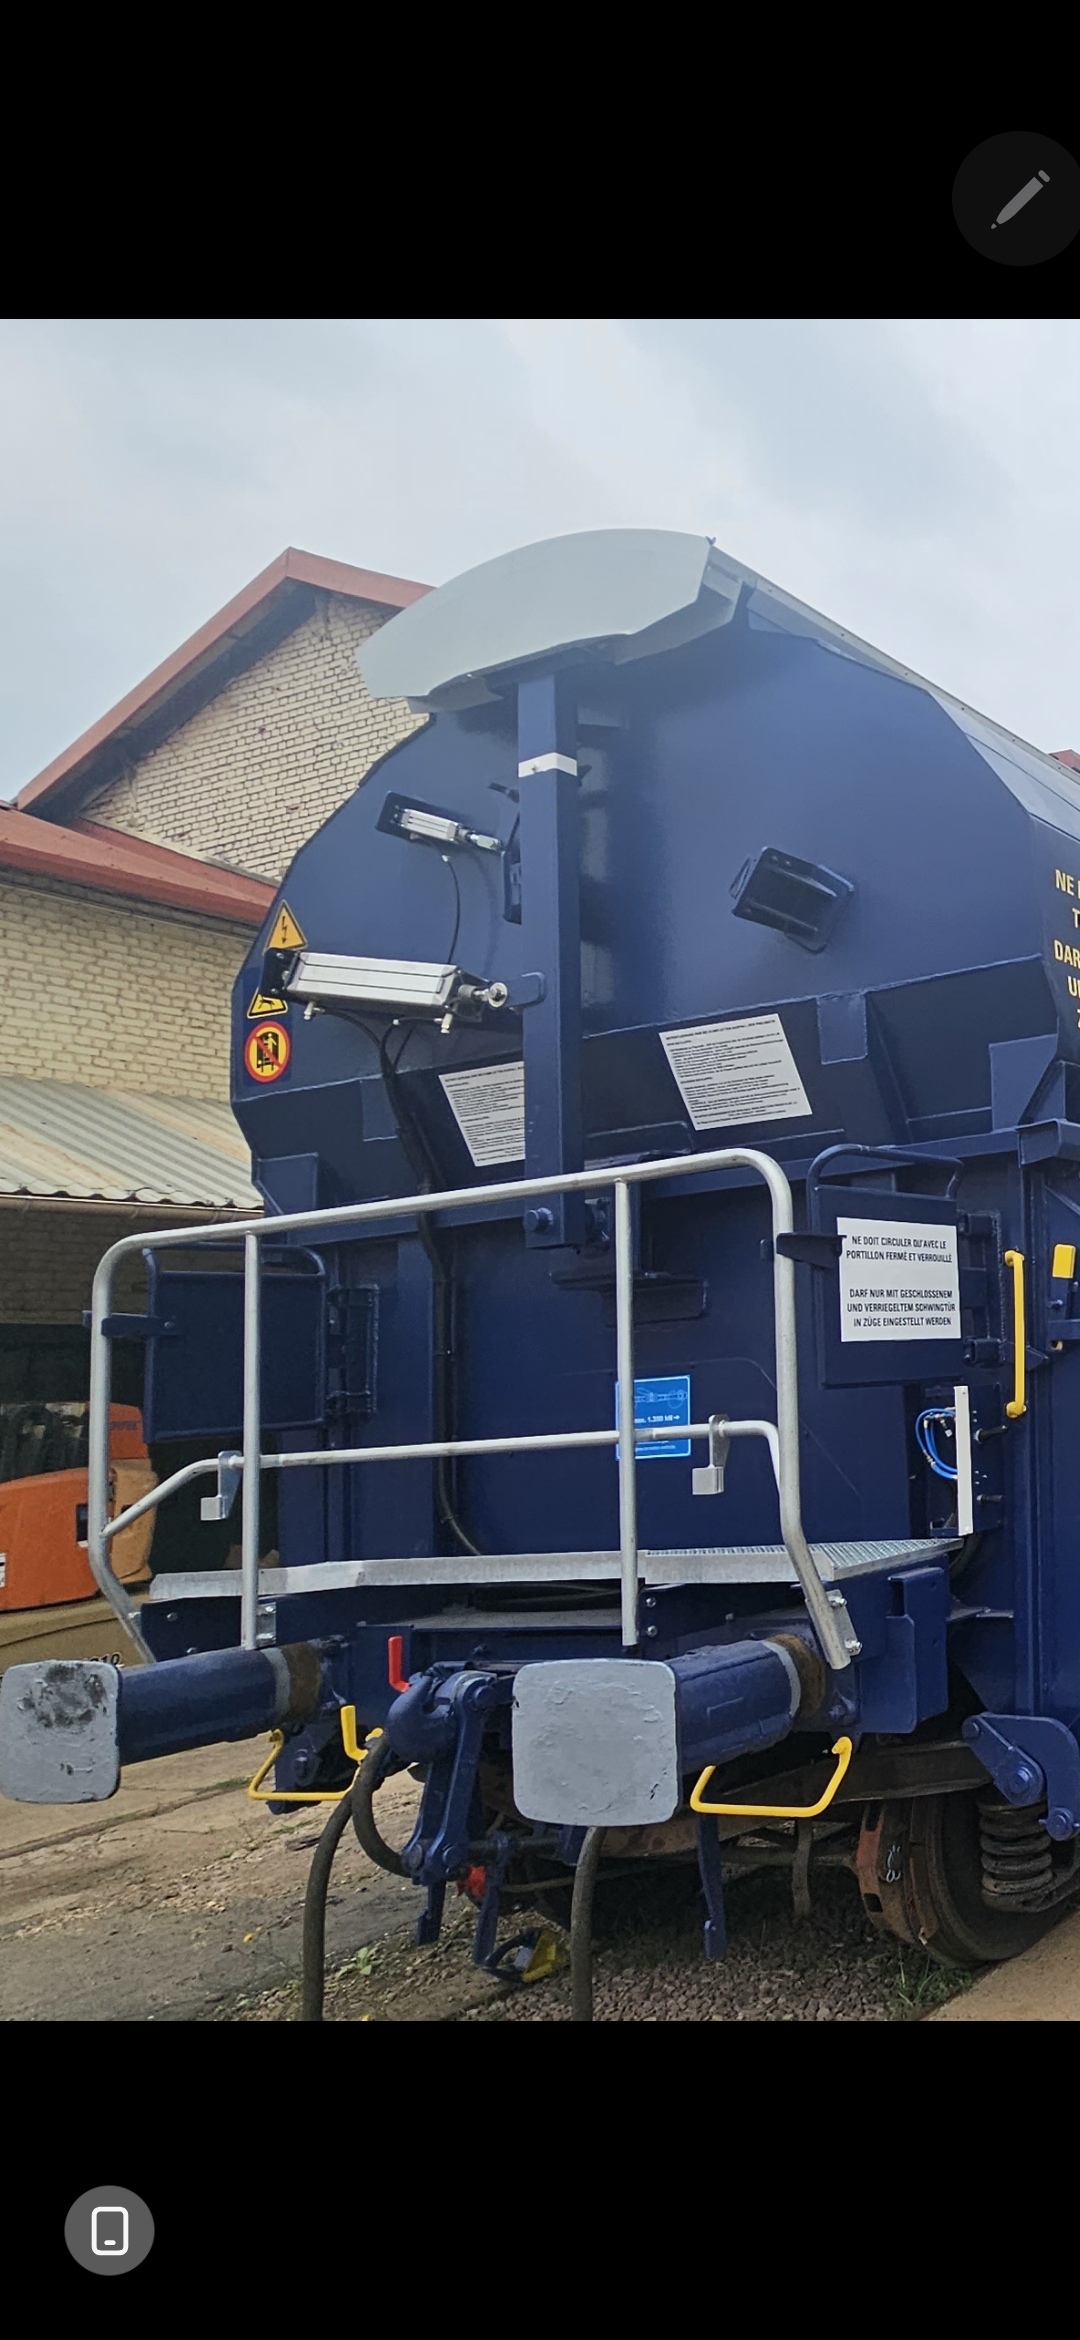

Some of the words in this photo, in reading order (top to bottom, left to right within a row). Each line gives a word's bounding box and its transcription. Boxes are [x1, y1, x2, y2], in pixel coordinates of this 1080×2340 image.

[1055, 868, 1075, 896] NE
[851, 1236, 861, 1245] NE
[863, 1237, 879, 1246] DOIT
[881, 1237, 912, 1248] CIRCULER
[913, 1239, 939, 1249] QU'AVEC
[940, 1240, 947, 1249] LE
[846, 1250, 885, 1260] PORTILLON
[886, 1250, 908, 1261] FERMÉ
[909, 1252, 916, 1261] ET
[849, 1289, 869, 1298] DARF
[870, 1289, 885, 1298] NUR
[886, 1289, 899, 1298] MIT
[900, 1289, 953, 1299] GESCHLOSSENEM
[847, 1303, 863, 1312] UND
[864, 1303, 914, 1312] VERRIEGELTEM
[915, 1301, 956, 1312] SCHWINGTÜR
[853, 1318, 862, 1327] IN
[863, 1315, 882, 1327] ZÜGE
[883, 1317, 924, 1327] EINGESTELLT
[925, 1316, 952, 1326] WERDEN
